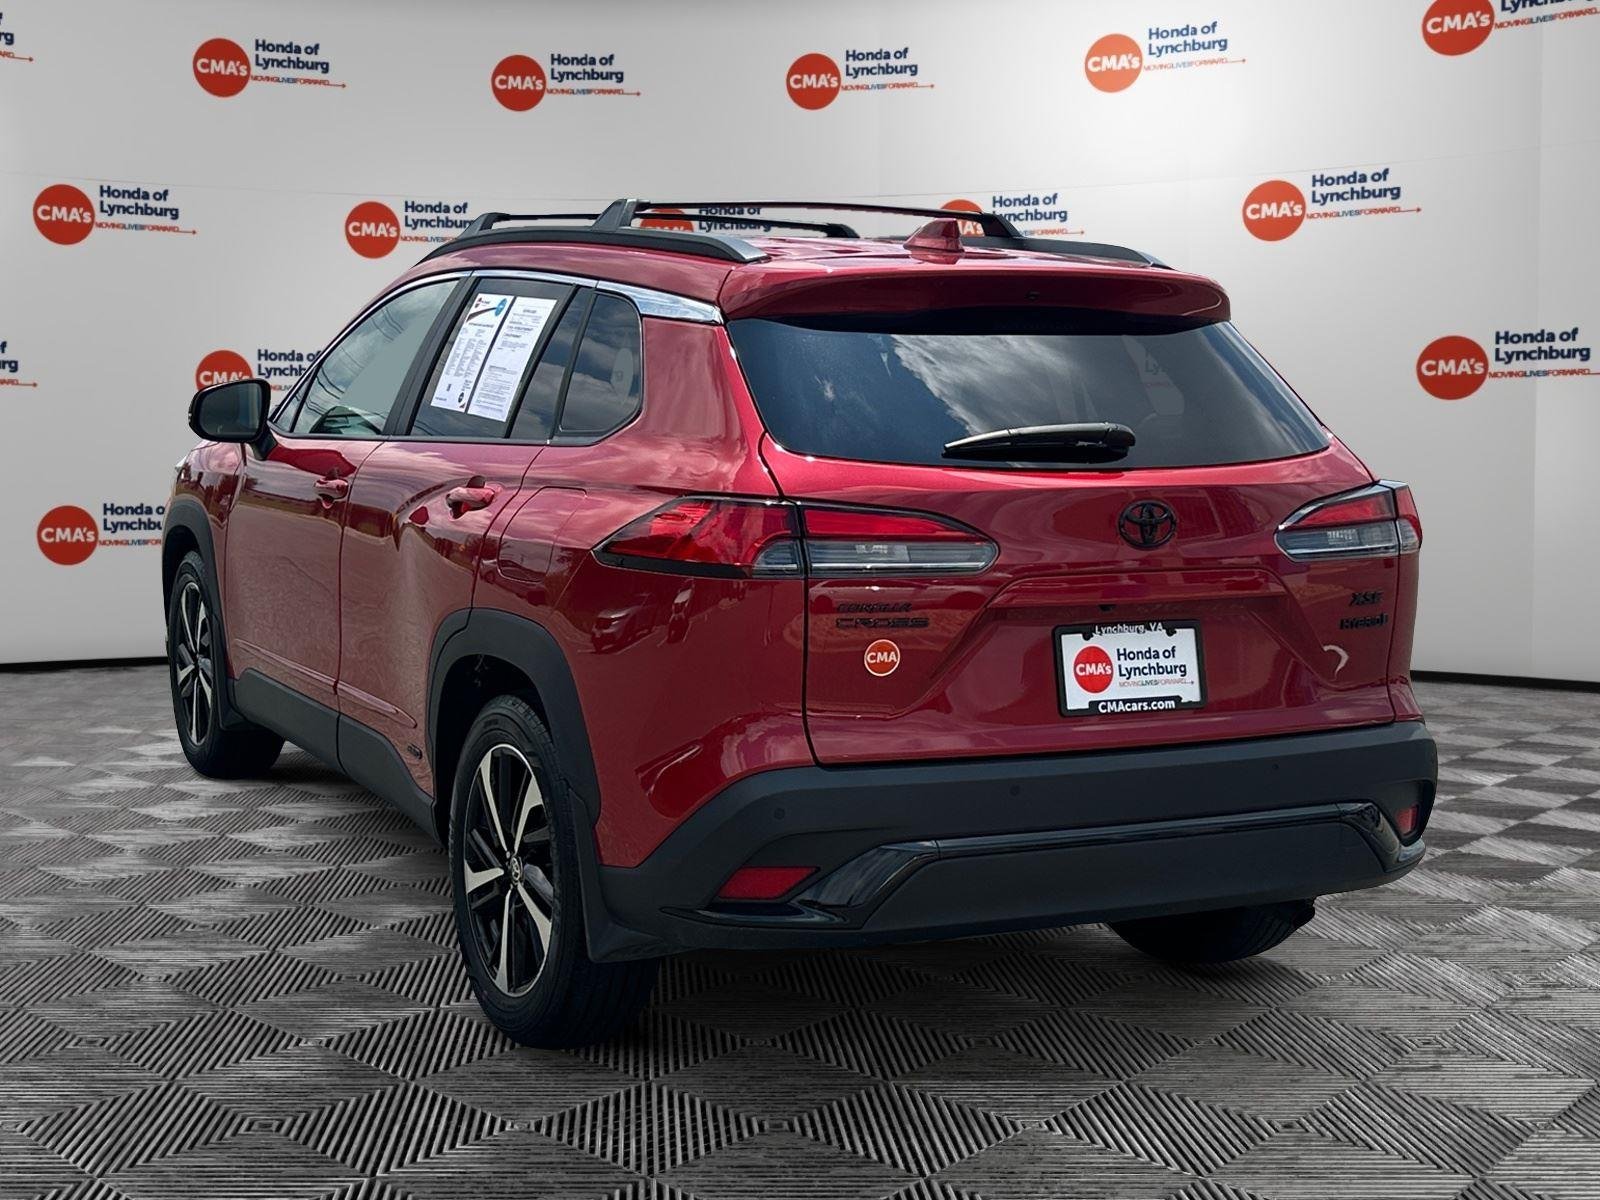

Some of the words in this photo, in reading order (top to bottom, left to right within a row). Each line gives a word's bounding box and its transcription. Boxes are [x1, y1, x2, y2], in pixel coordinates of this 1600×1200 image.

[1426, 11, 1491, 34] CMA's
[1149, 25, 1197, 40] Honda
[1201, 21, 1217, 34] of
[255, 39, 301, 54] Honda
[304, 43, 320, 55] of
[846, 49, 890, 62] Honda
[894, 47, 908, 60] of
[1149, 38, 1228, 57] Lynchburg
[196, 58, 248, 77] CMA's
[255, 54, 329, 74] Lynchburg
[551, 54, 596, 66] Honda
[599, 54, 614, 66] of
[1088, 53, 1140, 72] CMA's
[551, 68, 624, 83] Lynchburg
[846, 63, 918, 78] Lynchburg
[495, 75, 543, 90] CMA's
[790, 73, 838, 89] CMA's
[1312, 171, 1367, 187] Honda
[1371, 168, 1389, 182] of
[100, 185, 149, 200] Honda
[153, 189, 168, 201] of
[992, 195, 1039, 208] Honda
[1042, 193, 1058, 205] of
[1312, 186, 1400, 206] Lynchburg
[37, 205, 92, 223] CMA's
[100, 201, 179, 220] Lynchburg
[405, 201, 450, 213] Honda
[453, 202, 468, 213] of
[1246, 201, 1302, 219] CMA's
[405, 215, 474, 230] Lynchbur
[993, 208, 1067, 222] ynchburg
[348, 222, 397, 237] CMA's
[1495, 329, 1555, 345] Honda
[1559, 327, 1578, 341] of
[258, 349, 303, 362] Honda
[1495, 346, 1590, 364] Lynchburg
[1421, 358, 1484, 376] CMA's
[103, 503, 152, 515] Honda
[156, 506, 165, 515] o
[103, 518, 162, 533] Lynchb
[41, 527, 95, 542] CMA's
[1150, 622, 1163, 632] VA
[867, 652, 897, 663] CMA
[1117, 648, 1160, 661] Honda
[1162, 646, 1176, 659] of
[1076, 663, 1112, 676] CMA's
[1118, 662, 1187, 680] Lynchburg
[1098, 700, 1176, 713] CMAcars.com
